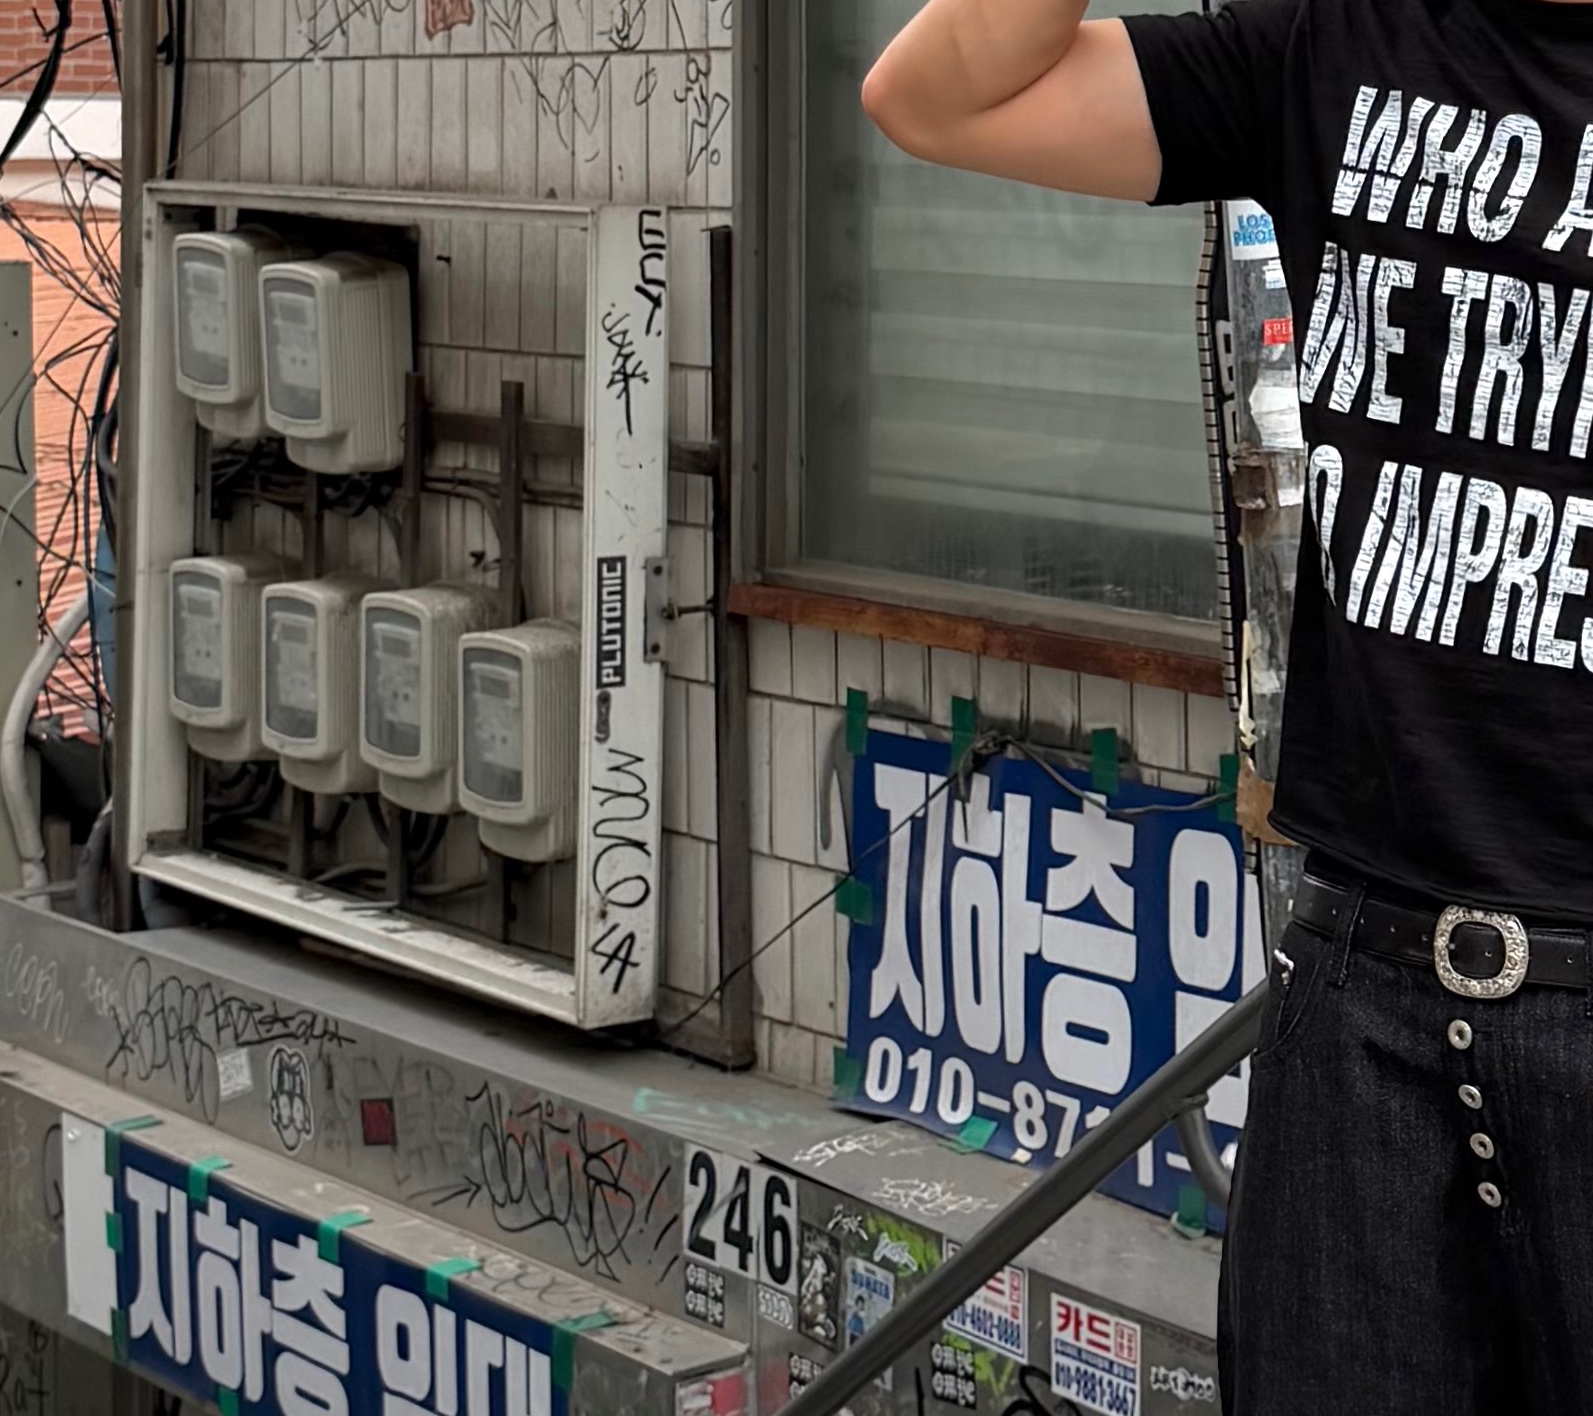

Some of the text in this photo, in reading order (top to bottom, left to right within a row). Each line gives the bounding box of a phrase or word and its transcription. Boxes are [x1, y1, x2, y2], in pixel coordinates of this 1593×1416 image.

[1237, 214, 1273, 230] LOS
[1331, 85, 1541, 242] WHO
[1300, 241, 1417, 423] WE
[1304, 441, 1343, 606] O
[601, 561, 623, 683] PLUTONIC
[869, 762, 1137, 1095] 지하층
[688, 1150, 793, 1285] 246
[1057, 1301, 1111, 1353] 카드
